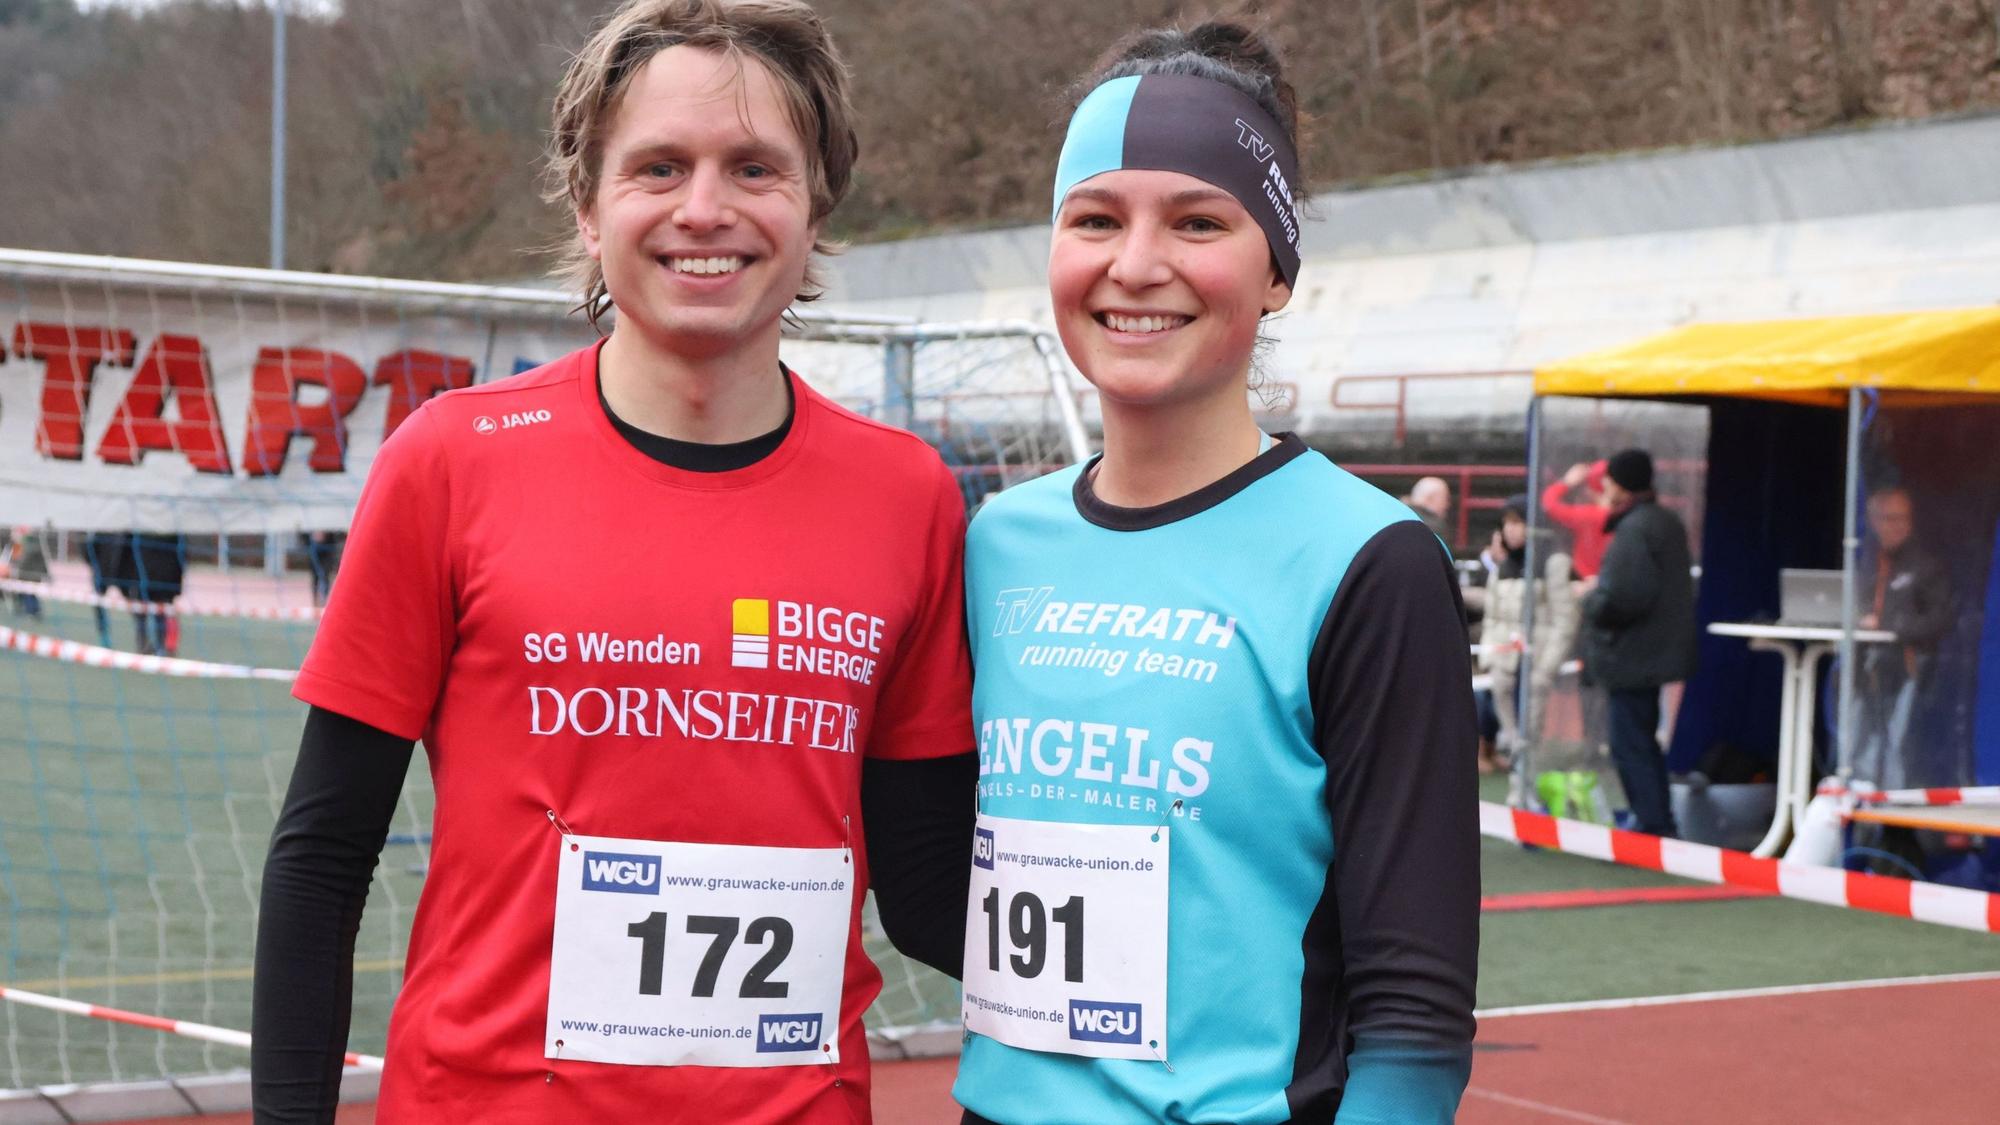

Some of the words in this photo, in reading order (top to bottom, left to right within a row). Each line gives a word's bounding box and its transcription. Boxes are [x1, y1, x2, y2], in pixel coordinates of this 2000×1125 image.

[1235, 118, 1275, 163] TV
[1262, 179, 1297, 244] running
[0, 322, 476, 476] TART
[501, 409, 551, 429] JAKO
[777, 601, 886, 654] BIGGE
[1034, 602, 1237, 649] REFRATH
[524, 632, 567, 663] SG
[576, 632, 701, 665] Wenden
[776, 645, 877, 685] ENERGIE
[1019, 642, 1129, 677] running
[1134, 648, 1219, 683] team
[979, 718, 1214, 797] ENGELS
[588, 859, 657, 885] WGU
[996, 850, 1154, 872] www.grauwacke-union.de
[666, 874, 845, 892] www.grauwacke-union.de
[627, 911, 794, 998] 172
[983, 886, 1084, 984] 191
[966, 993, 1064, 1023] www.grauwacke-union.de
[1073, 1007, 1138, 1035] WGU
[561, 1019, 752, 1039] www.grauwacke-union.de
[762, 1020, 819, 1043] WGU
